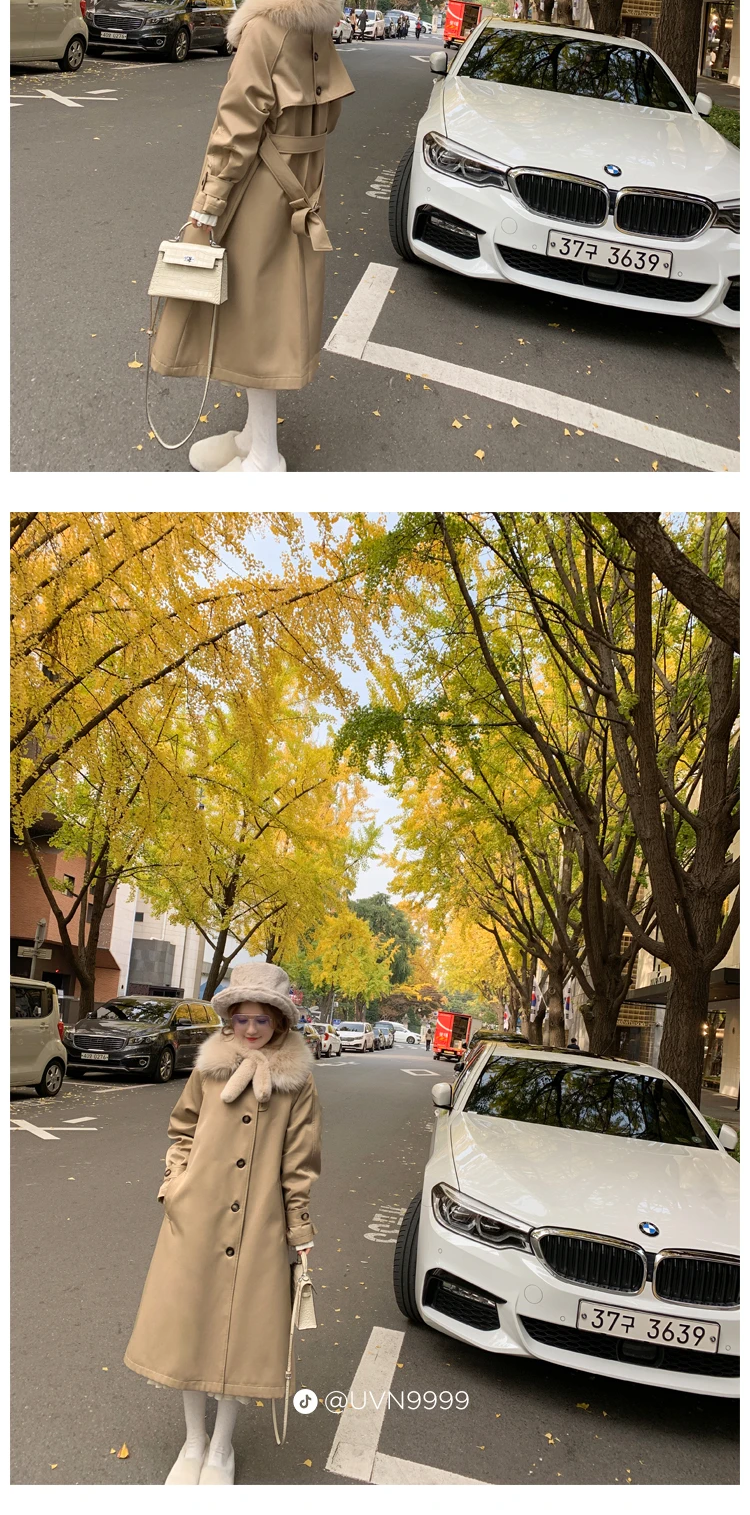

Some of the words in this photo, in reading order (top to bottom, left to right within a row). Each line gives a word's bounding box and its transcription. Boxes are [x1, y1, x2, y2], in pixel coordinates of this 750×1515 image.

[559, 237, 598, 260] 37구
[607, 246, 660, 272] 3639
[591, 1308, 635, 1334] 37구
[646, 1318, 706, 1347] 3639
